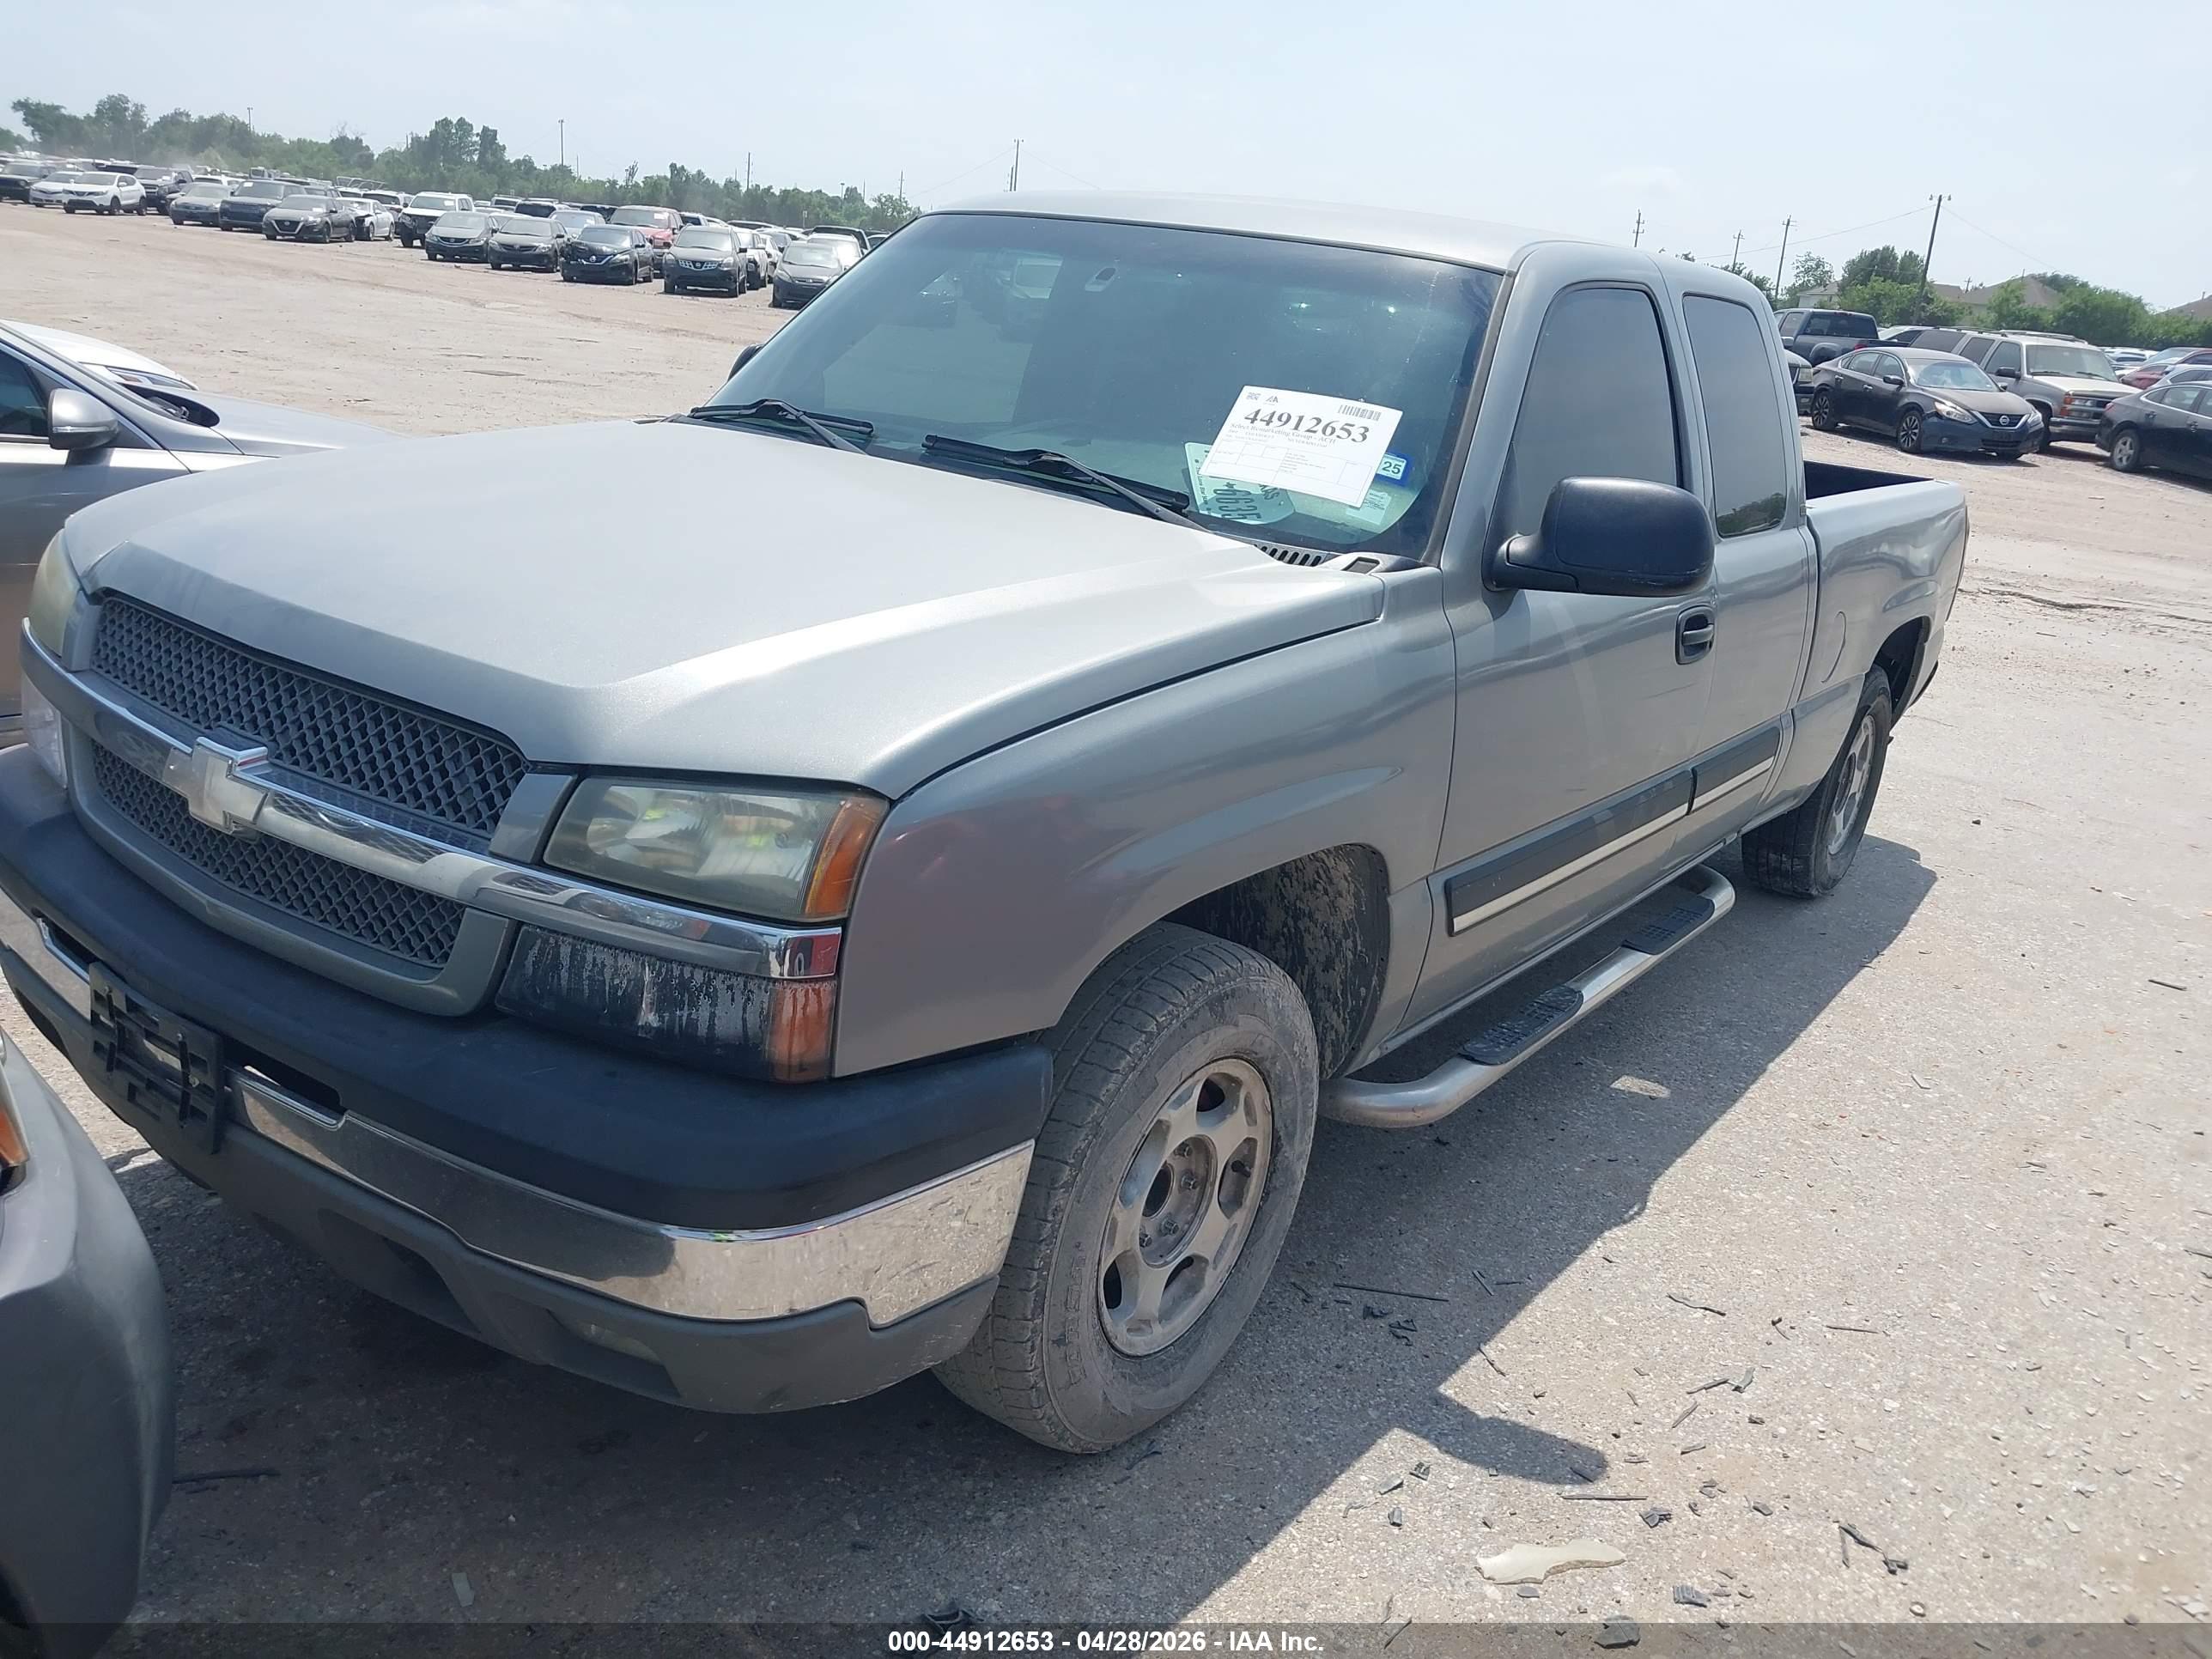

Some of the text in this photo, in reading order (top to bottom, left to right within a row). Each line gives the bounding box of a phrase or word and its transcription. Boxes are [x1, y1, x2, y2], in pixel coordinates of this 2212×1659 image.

[1244, 407, 1370, 443] 44912653
[1382, 461, 1402, 475] 25
[1212, 489, 1262, 520] 6635
